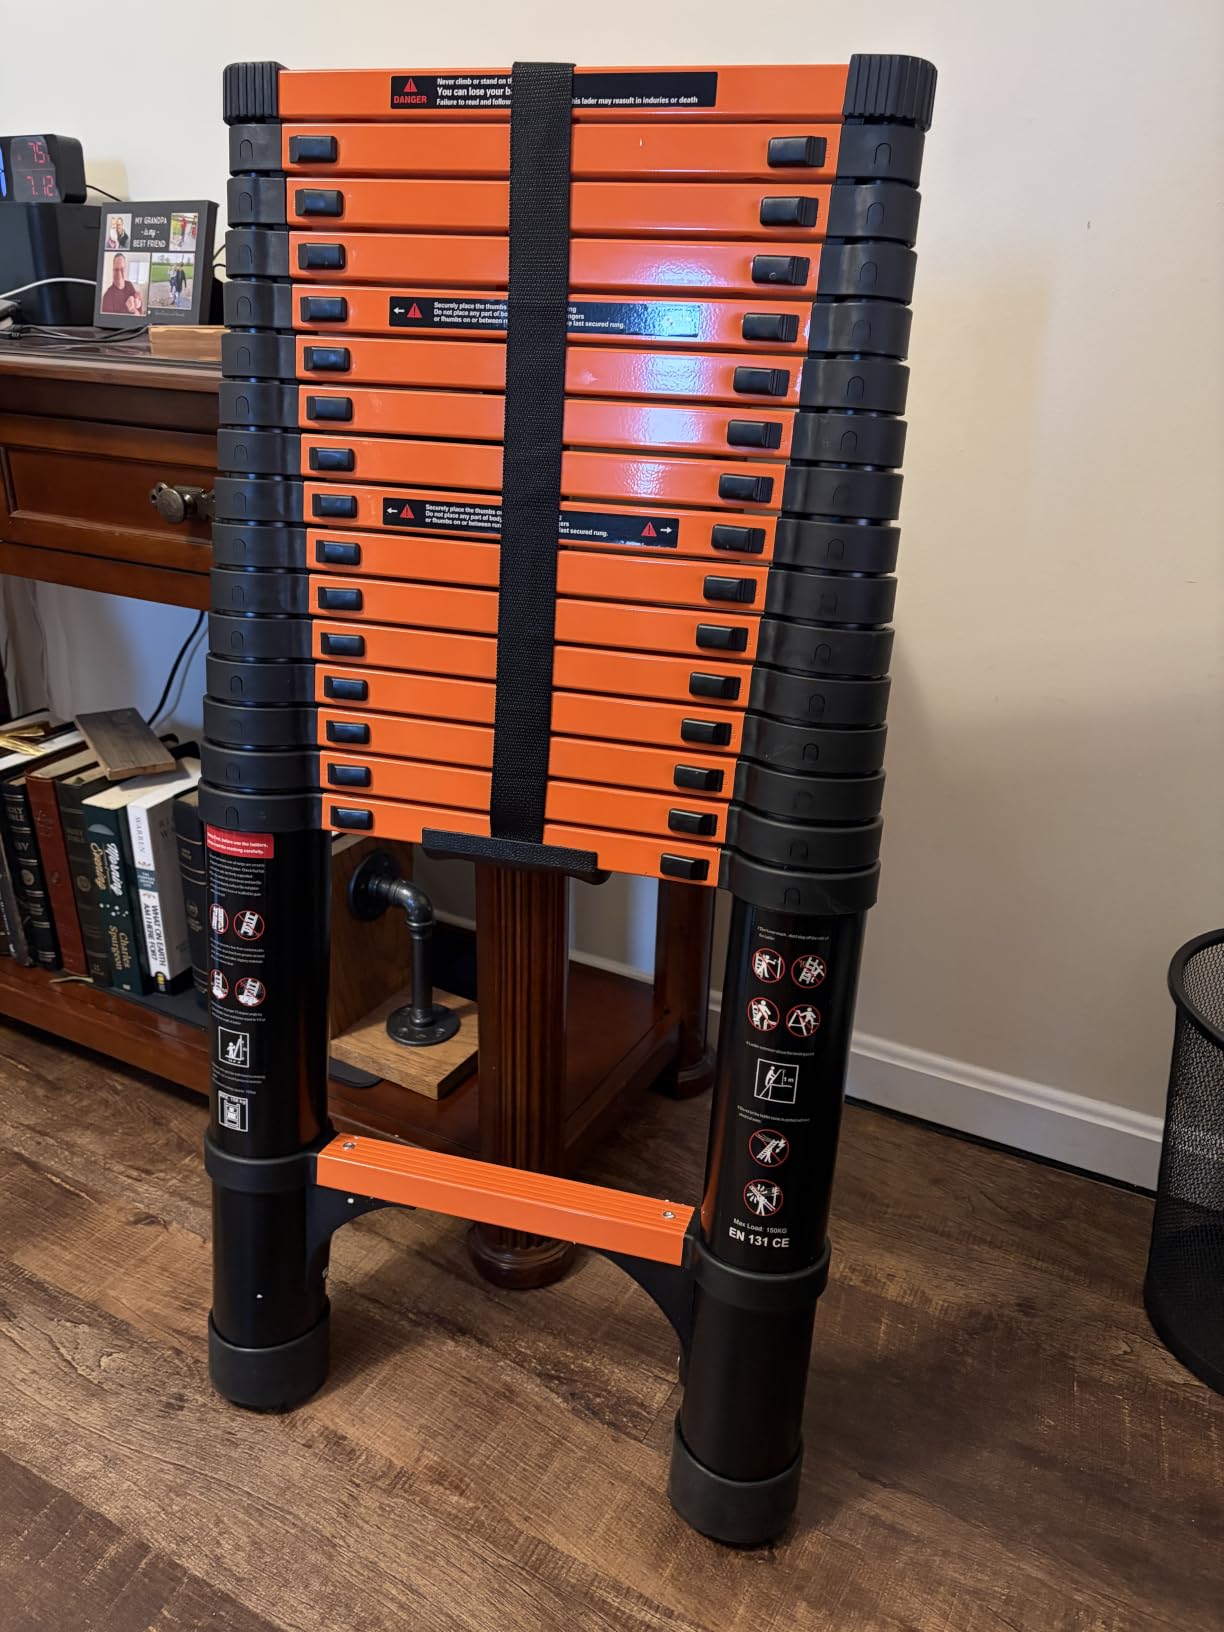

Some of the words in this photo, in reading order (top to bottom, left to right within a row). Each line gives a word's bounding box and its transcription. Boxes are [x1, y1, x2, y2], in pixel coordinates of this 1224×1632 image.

[437, 88, 452, 96] You
[469, 87, 484, 95] lose
[486, 88, 504, 97] your
[28, 142, 46, 164] 75
[136, 817, 145, 853] WARREN
[90, 842, 106, 890] Evening
[105, 843, 123, 896] Morning
[144, 903, 151, 917] AM
[152, 905, 160, 927] WHAT
[155, 928, 162, 941] ON
[109, 925, 122, 970] Spurgeon
[120, 932, 132, 968] Charles
[157, 942, 166, 966] EARTH
[734, 1218, 745, 1227] Max
[747, 1223, 764, 1232] Load:
[729, 1227, 745, 1241] EN
[748, 1234, 768, 1247] 131
[772, 1238, 790, 1248] CE
